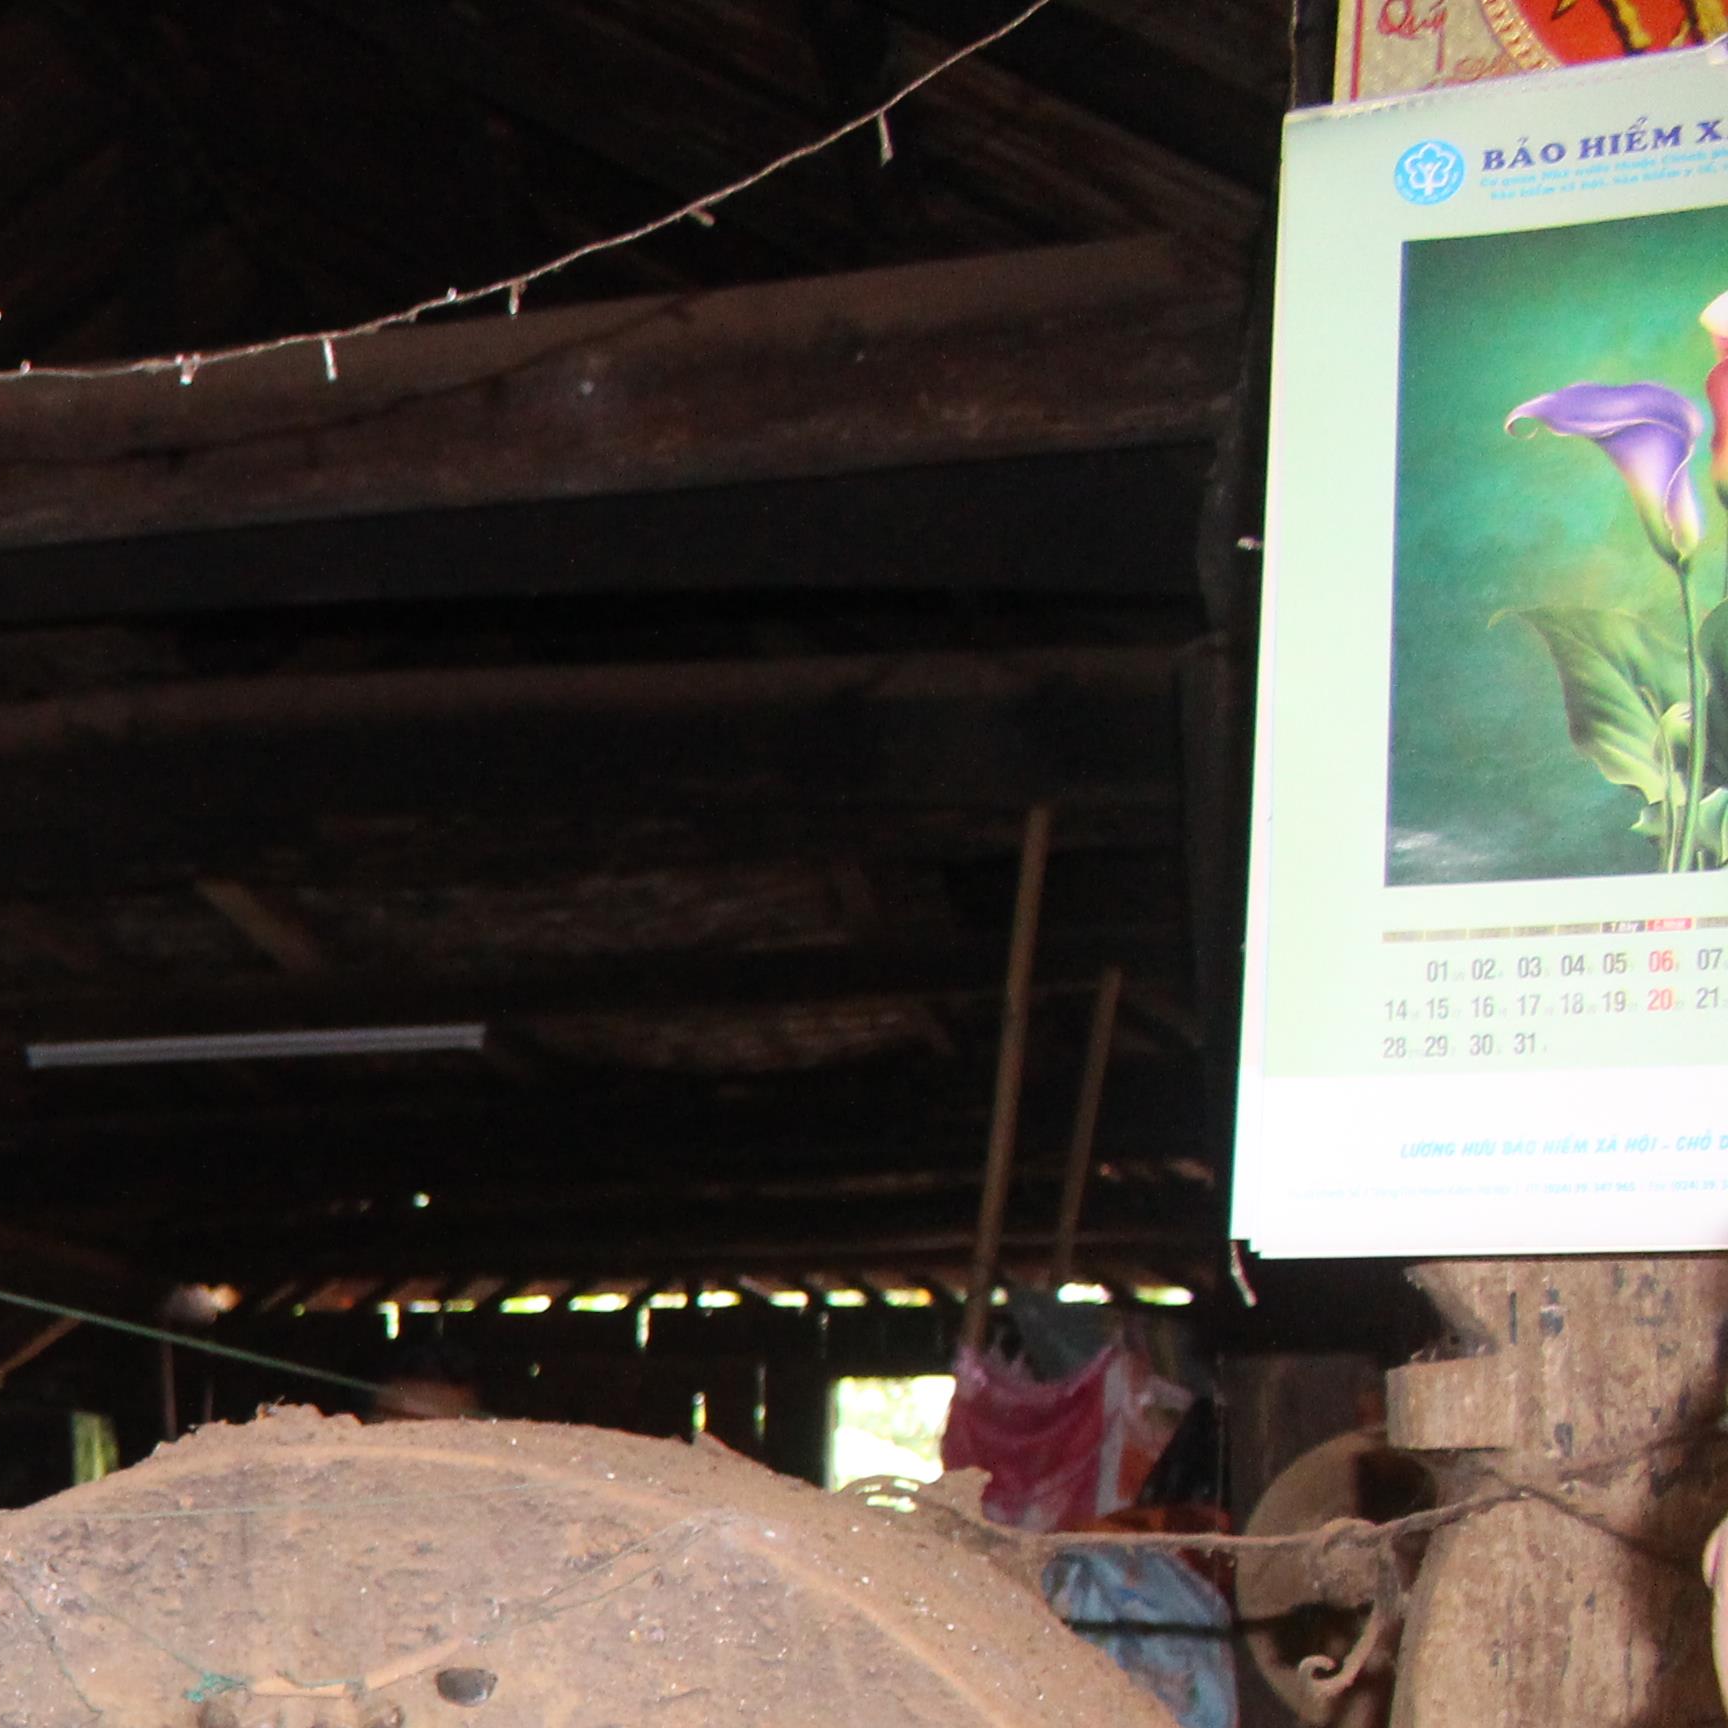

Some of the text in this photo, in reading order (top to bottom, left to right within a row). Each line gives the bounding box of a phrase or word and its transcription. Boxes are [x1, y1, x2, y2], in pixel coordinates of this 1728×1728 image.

[1482, 115, 1728, 172] BẢO HIỂM X
[1426, 949, 1722, 982] 01 02 03 04 05 06 07
[1385, 987, 1719, 1020] 14 15 16 17 18 19 20 21
[1383, 1033, 1536, 1059] 28 29 30 31
